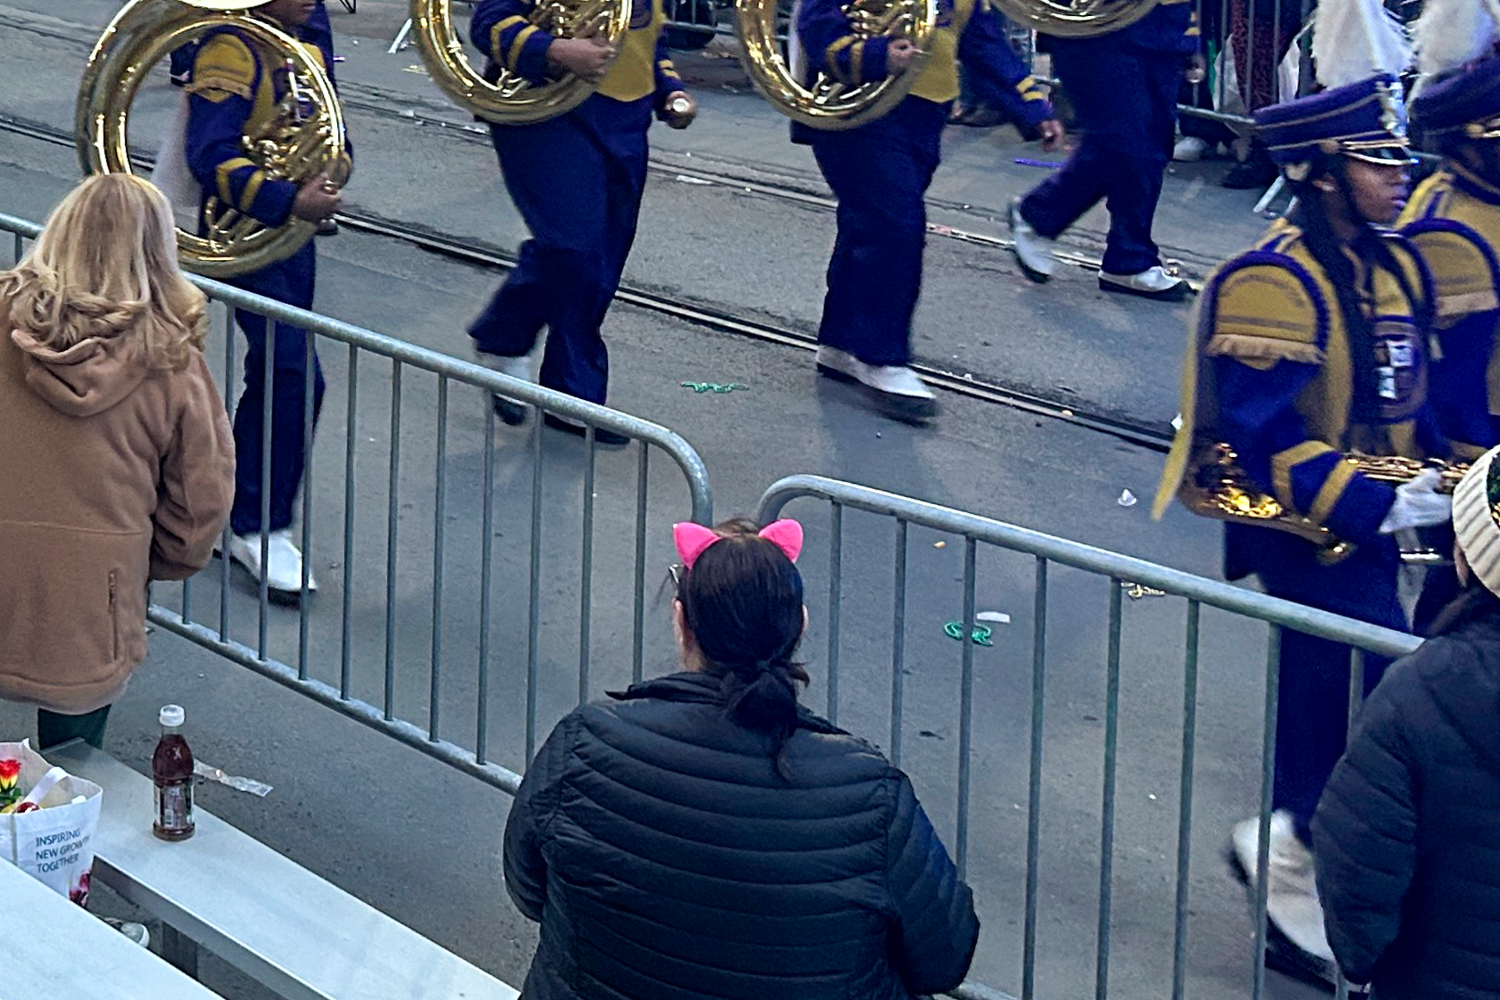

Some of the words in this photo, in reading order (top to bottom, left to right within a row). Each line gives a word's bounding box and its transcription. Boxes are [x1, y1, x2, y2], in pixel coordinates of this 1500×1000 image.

[36, 828, 81, 848] INSPIRING
[36, 847, 59, 861] NEW
[36, 853, 80, 873] TOGETHER
